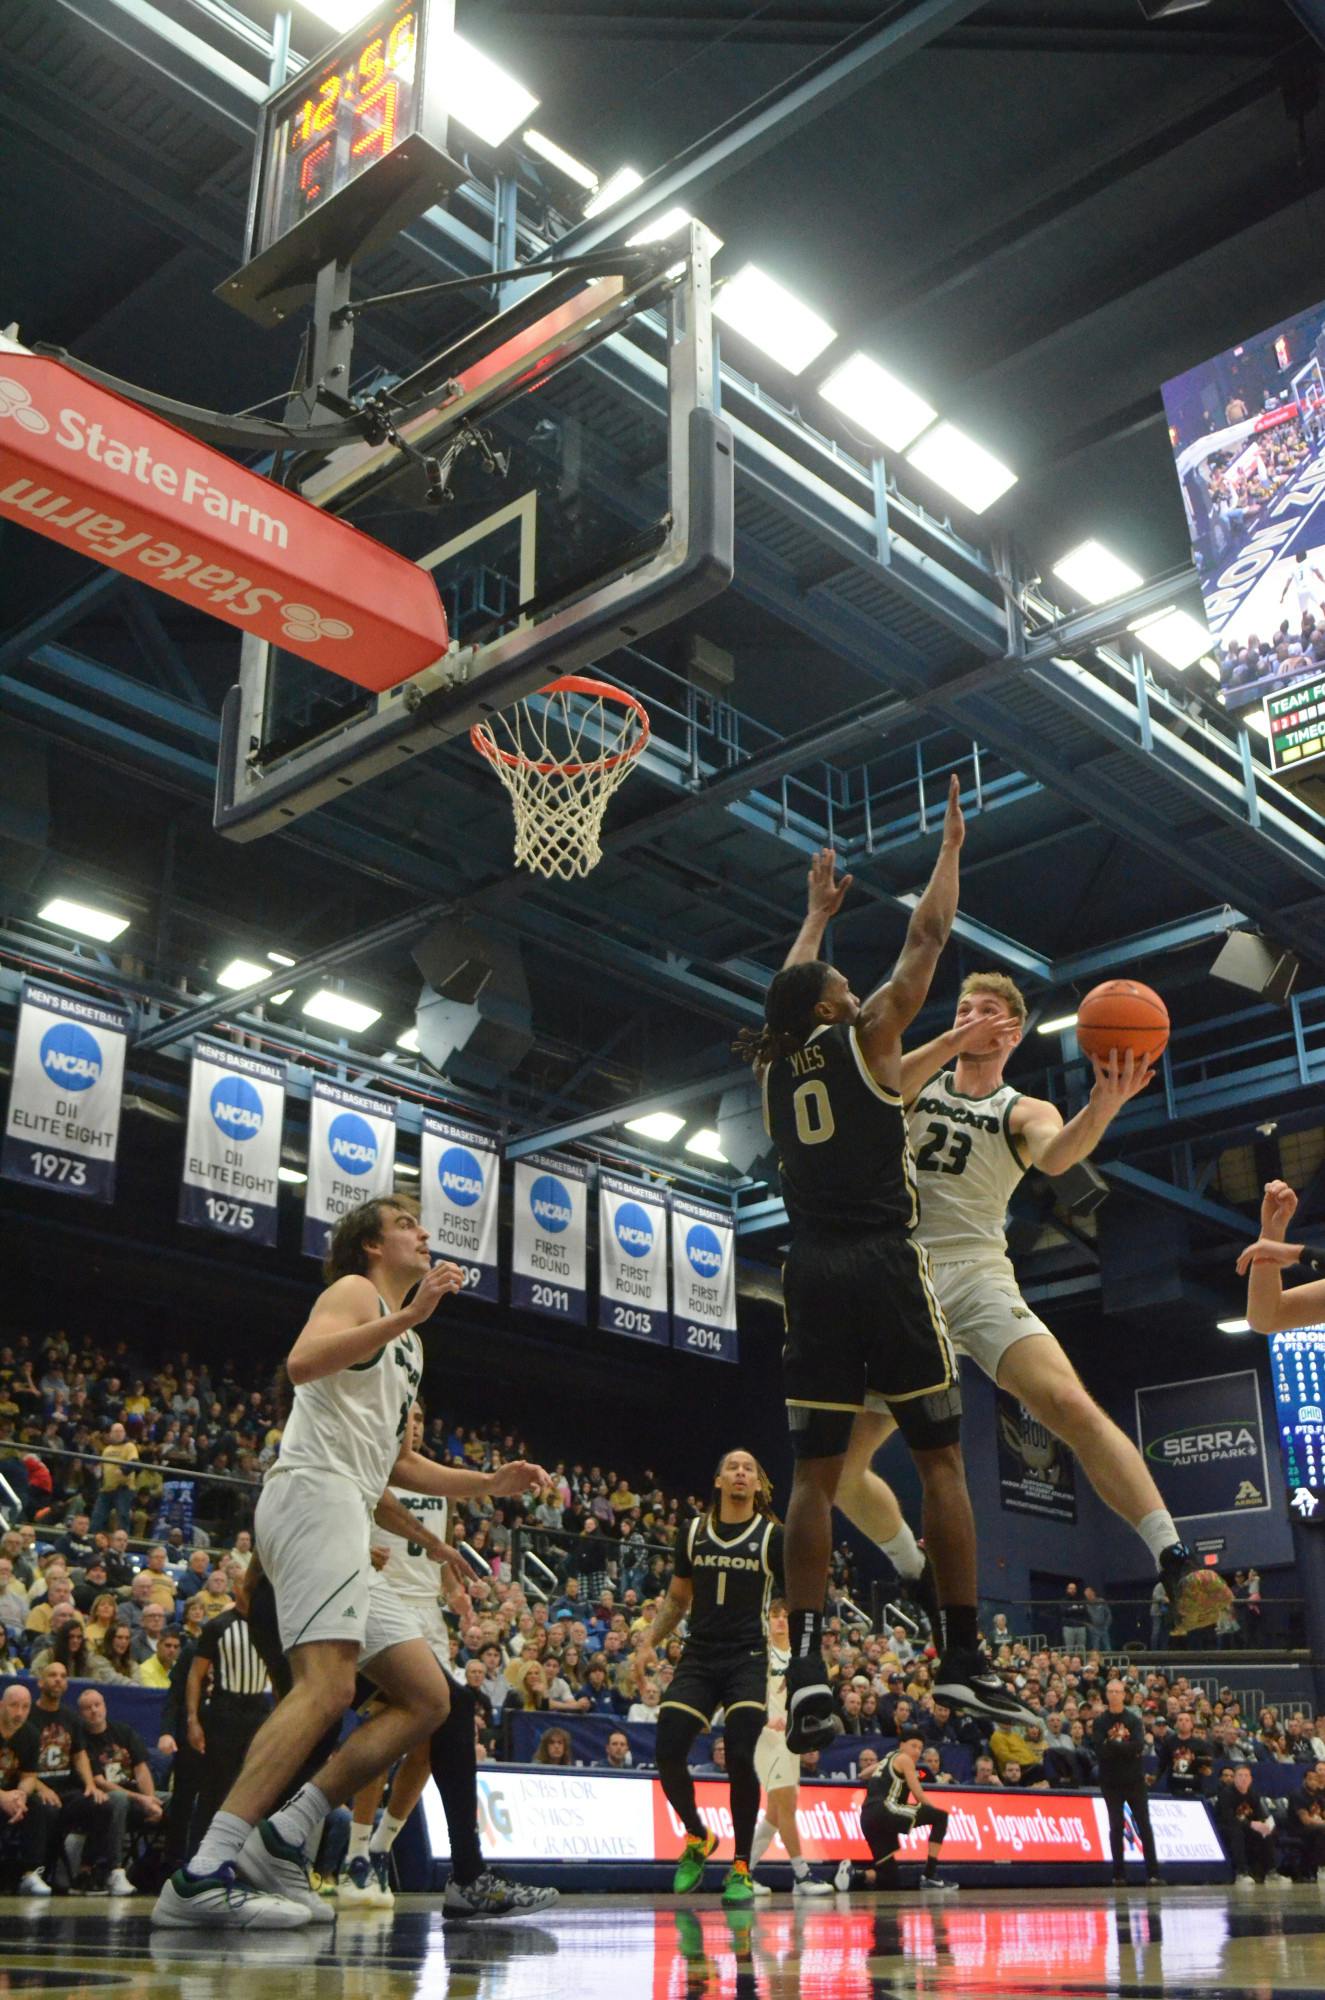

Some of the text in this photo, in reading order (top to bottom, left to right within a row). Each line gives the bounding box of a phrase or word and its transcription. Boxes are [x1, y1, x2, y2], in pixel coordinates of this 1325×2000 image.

[1271, 690, 1309, 714] TEAM
[27, 987, 125, 1028] MEN'S BASKETBALL
[45, 1049, 101, 1080] NCAA
[197, 1043, 283, 1080] MEN'S BASKETBALL
[787, 1044, 825, 1077] YLES
[55, 1100, 77, 1119] DII
[316, 1082, 393, 1115] MEN'S BASKETBALL
[215, 1101, 262, 1131] NCAA
[793, 1079, 835, 1145] 0
[12, 1108, 113, 1149] ELITE EIGHT
[425, 1118, 496, 1149] MEN'S BASKETBALL
[225, 1149, 243, 1167] DII
[332, 1137, 377, 1163] NCAA
[915, 1121, 973, 1176] 23
[30, 1151, 87, 1186] 1973
[189, 1158, 275, 1195] ELITE EIGHT
[540, 1156, 584, 1177] BASKETBALL
[332, 1180, 370, 1202] FIRST
[443, 1171, 483, 1196] NCAA
[623, 1183, 664, 1203] BASKETBALL
[206, 1198, 254, 1229] 1975
[443, 1212, 477, 1233] FIRST
[534, 1199, 571, 1223] NCAA
[699, 1207, 733, 1225] BASKETBALL
[438, 1228, 480, 1251] ROUND
[618, 1225, 652, 1246] NCAA
[535, 1239, 566, 1258] FIRST
[689, 1246, 721, 1267] NCAA
[531, 1254, 570, 1276] ROUND
[620, 1264, 649, 1281] FIRST
[531, 1284, 569, 1312] 2011
[616, 1278, 652, 1298] ROUND
[691, 1284, 719, 1301] FIRST
[688, 1298, 723, 1317] ROUND
[614, 1307, 652, 1333] 2013
[687, 1325, 722, 1351] 2014
[1301, 1407, 1321, 1419] OHIO
[1163, 1428, 1255, 1456] SERRA
[1173, 1448, 1247, 1466] AUTO PARK
[1299, 1504, 1315, 1516] 17
[694, 1555, 759, 1571] AKRON
[716, 1571, 727, 1605] 1
[520, 1779, 598, 1801] JOBS FOR
[528, 1808, 585, 1826] OHIO'S
[533, 1834, 638, 1855] GRADUATES
